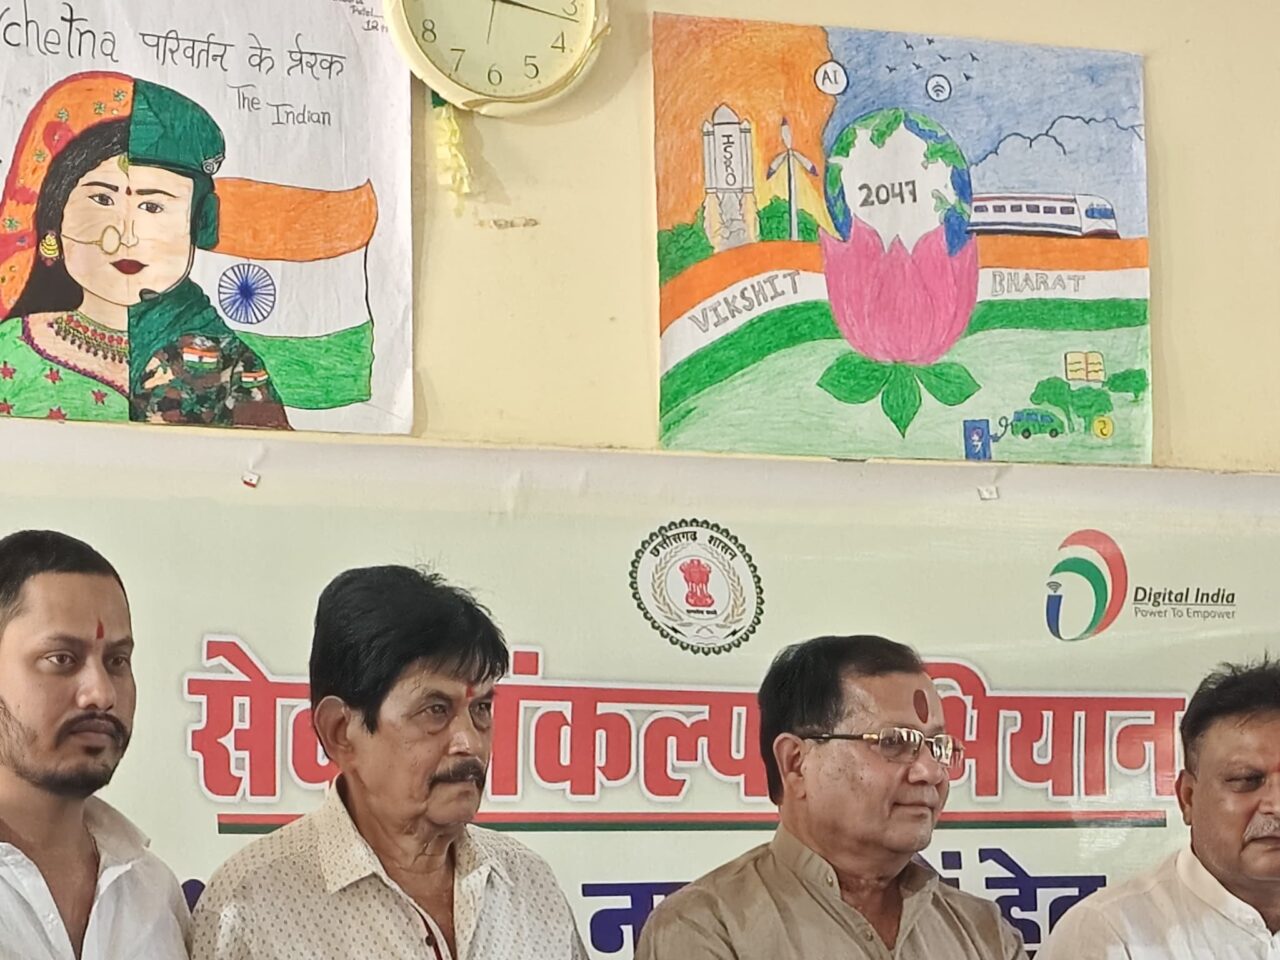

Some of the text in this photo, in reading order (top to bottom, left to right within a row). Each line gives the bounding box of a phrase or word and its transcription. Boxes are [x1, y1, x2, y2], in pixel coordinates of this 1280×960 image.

[421, 18, 437, 44] 8
[550, 31, 567, 54] 4
[248, 33, 275, 75] के
[450, 48, 466, 73] 7
[487, 63, 503, 86] 6
[523, 55, 540, 80] 5
[820, 69, 840, 86] AI
[227, 83, 332, 126] The Indian
[721, 134, 738, 187] ISRO
[858, 178, 919, 208] 2047
[991, 270, 1087, 297] BHARAT
[688, 268, 804, 335] VIKSHIT
[707, 534, 738, 561] शासन
[1133, 586, 1235, 607] Digital India
[1134, 606, 1236, 621] Power To Empower
